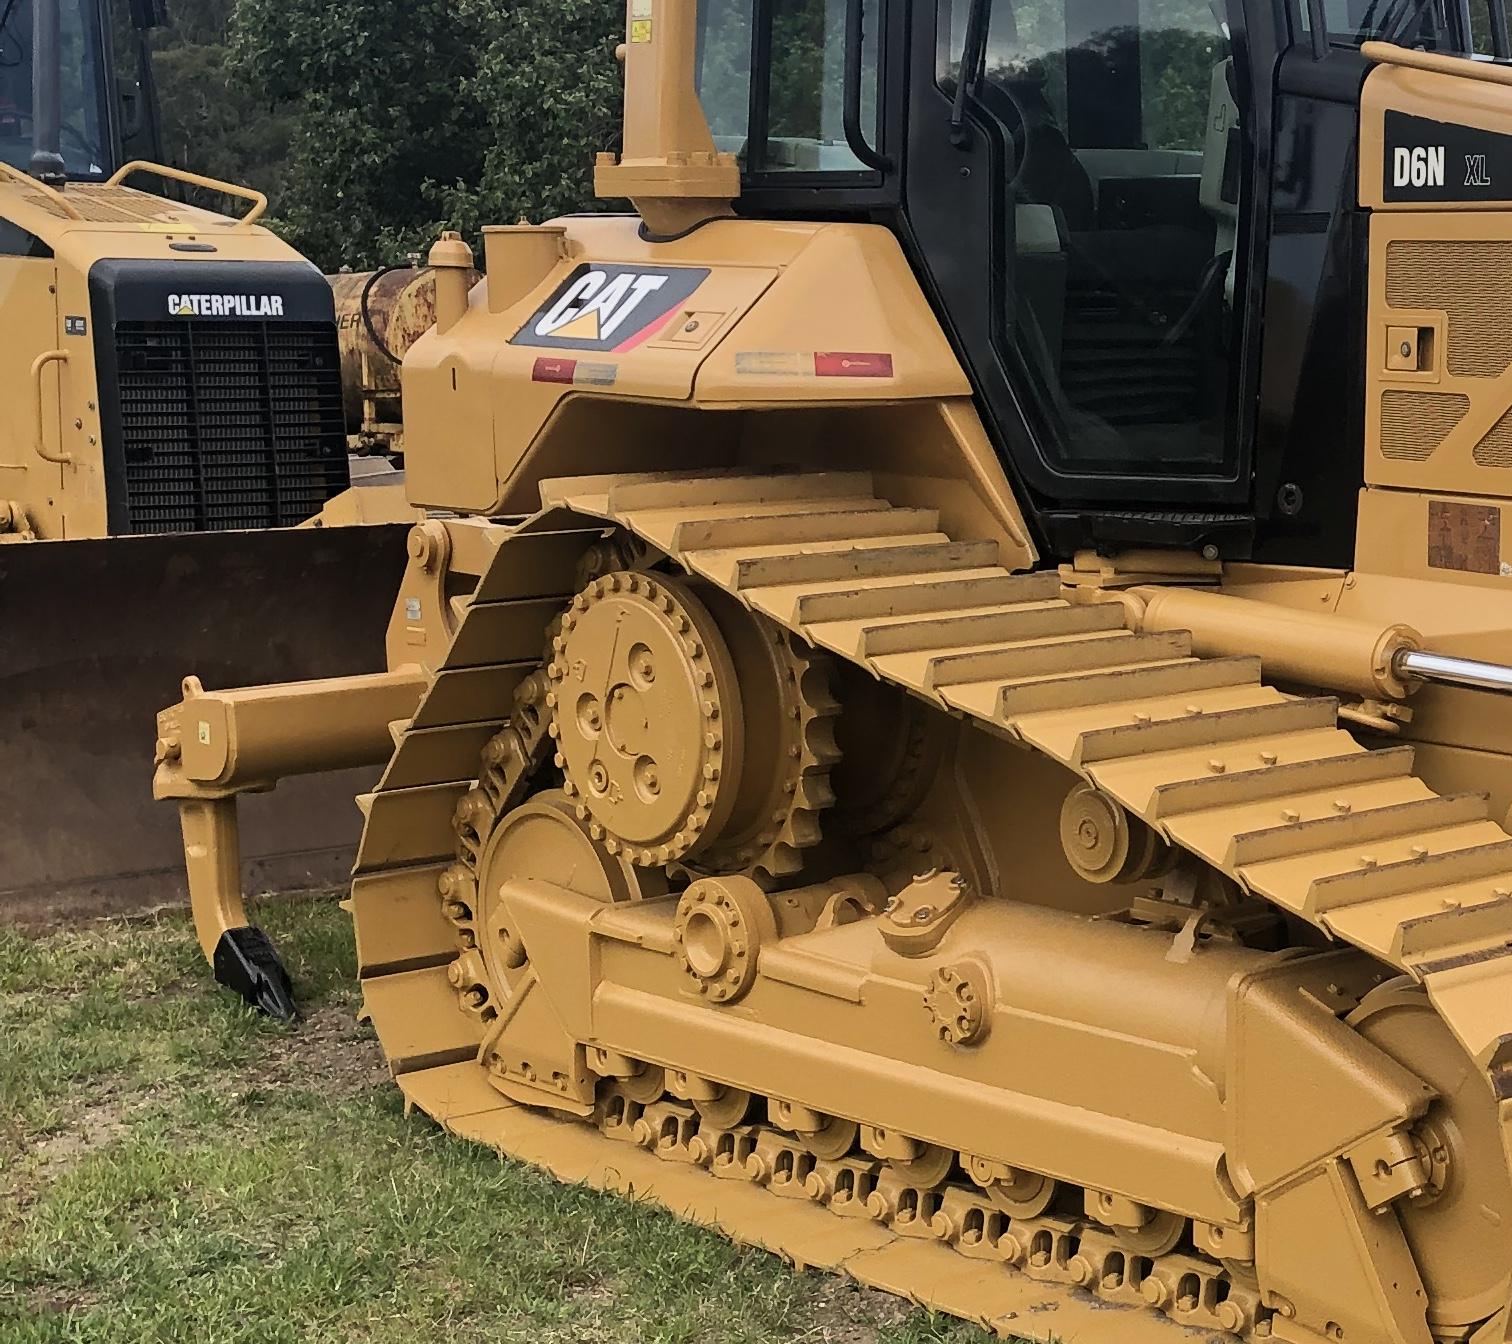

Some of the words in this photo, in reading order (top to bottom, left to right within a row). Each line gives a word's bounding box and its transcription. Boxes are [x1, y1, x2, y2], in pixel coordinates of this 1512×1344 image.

[1393, 146, 1445, 187] D6N
[1463, 154, 1491, 186] XL
[168, 294, 284, 316] CATERPILLAR
[534, 270, 669, 341] CAT
